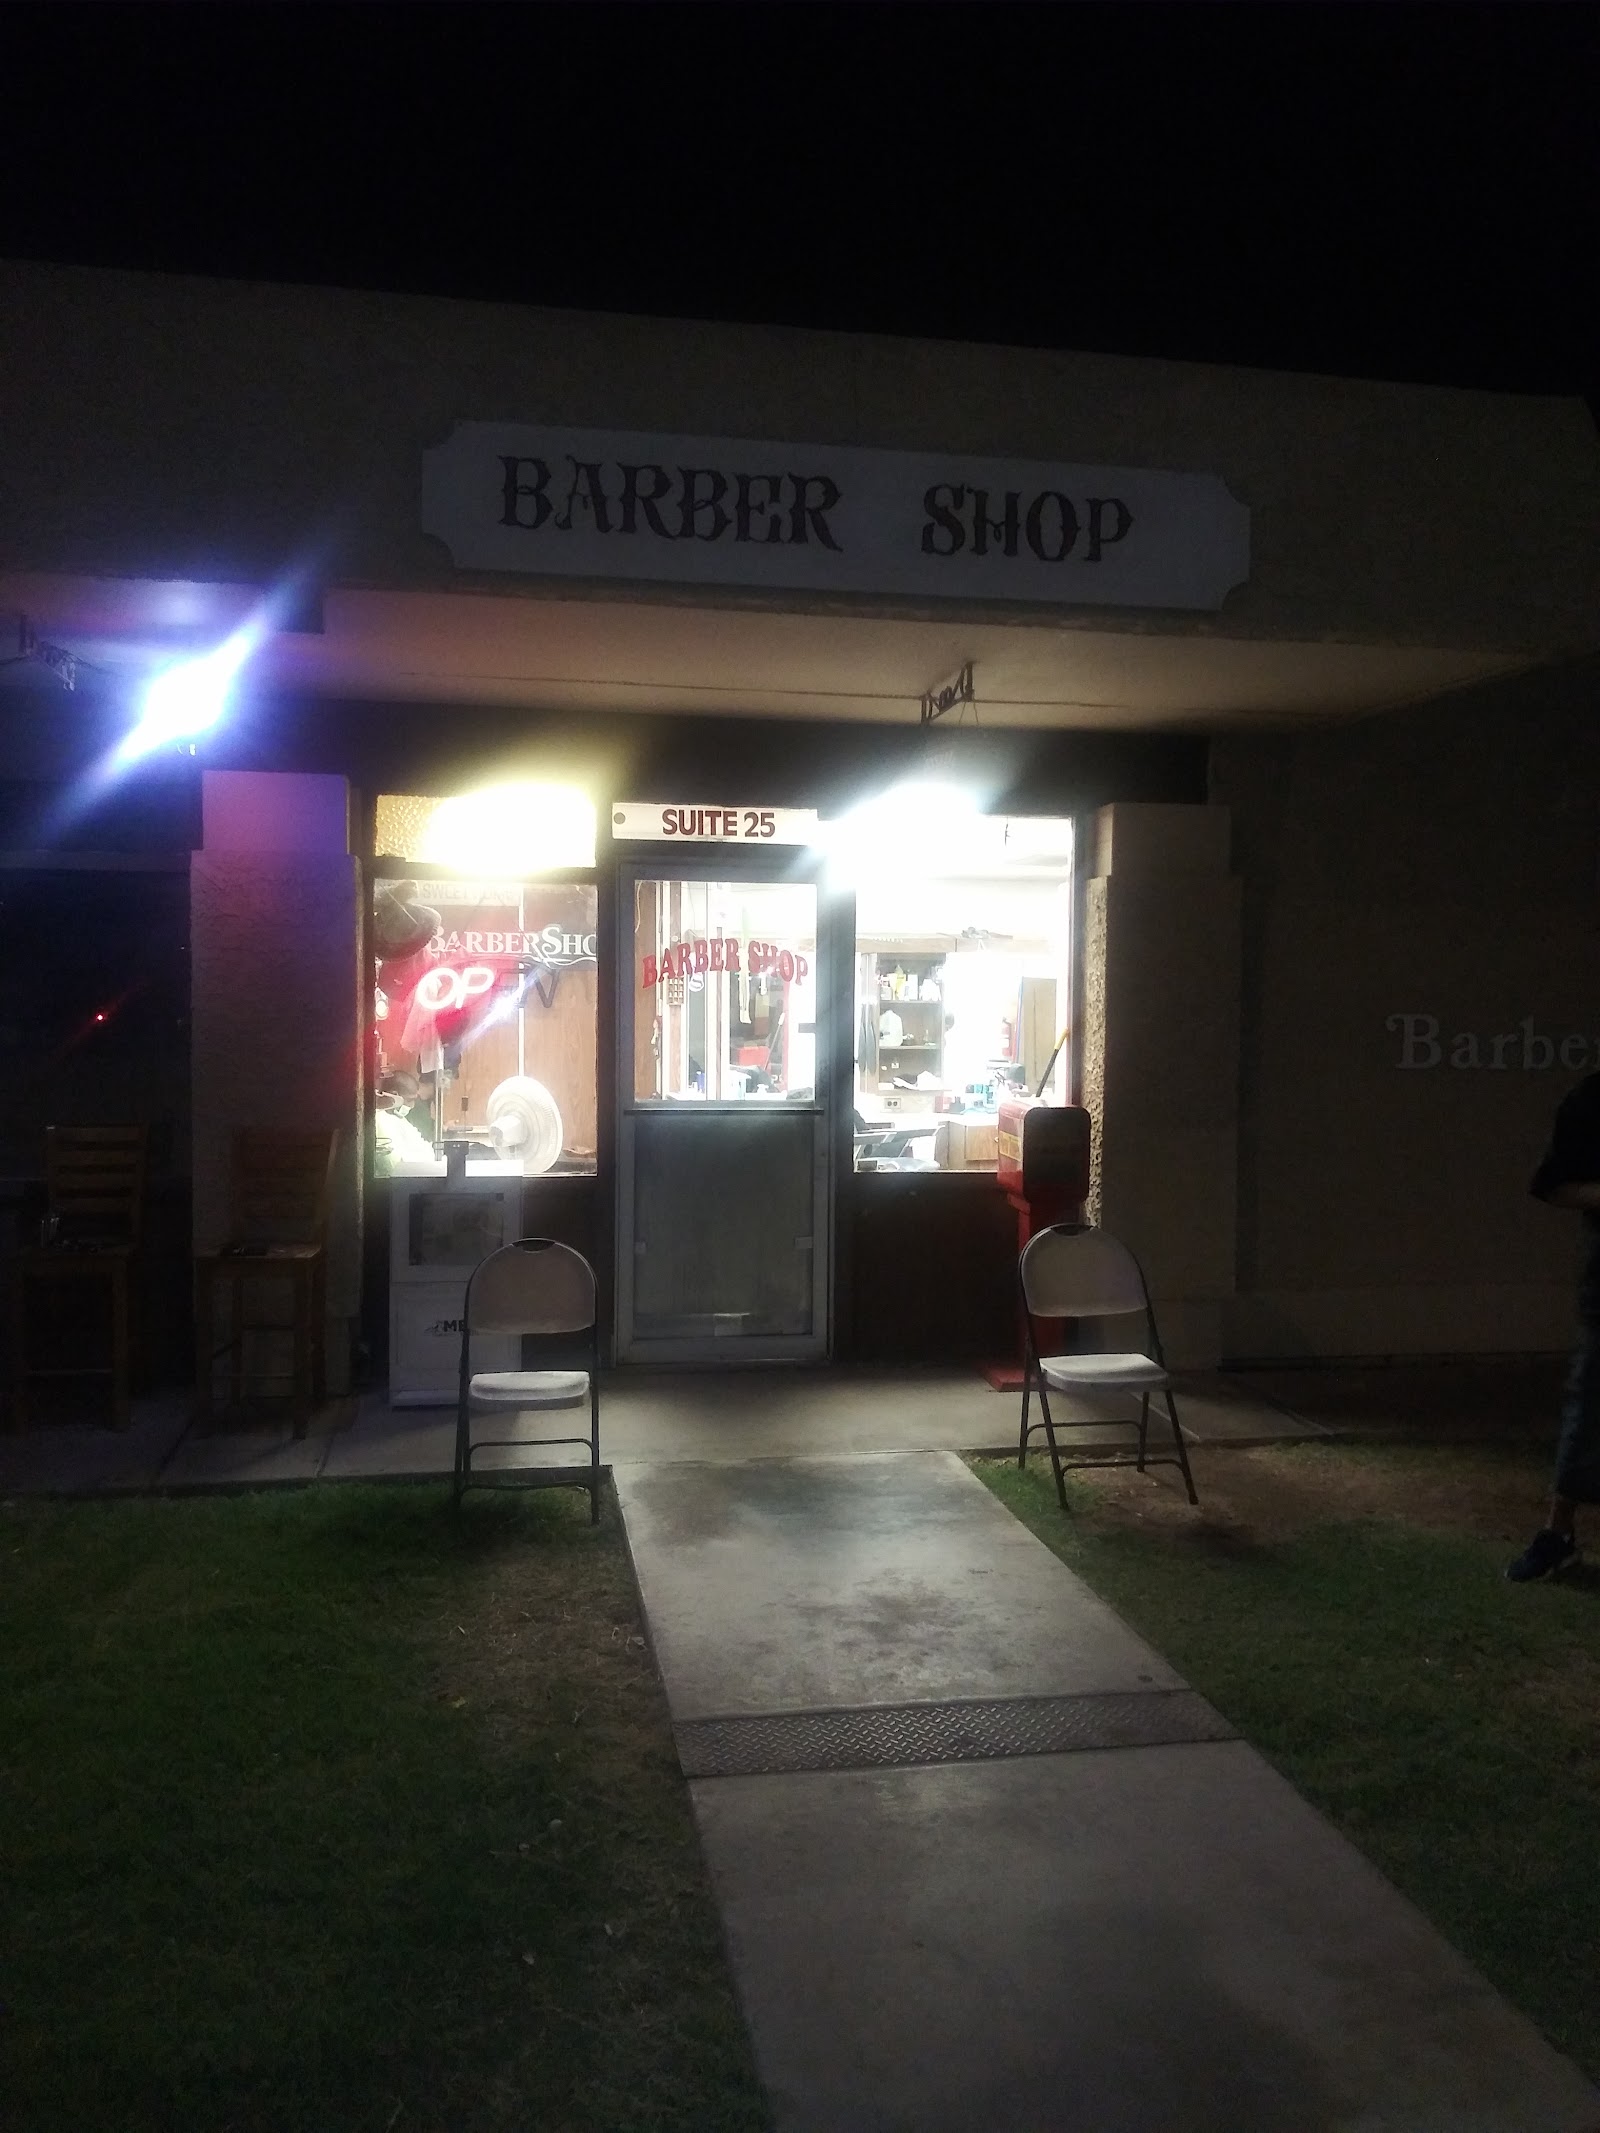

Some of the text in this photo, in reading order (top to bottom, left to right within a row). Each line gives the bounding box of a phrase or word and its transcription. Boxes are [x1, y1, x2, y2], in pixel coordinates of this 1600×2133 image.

[498, 455, 1134, 562] BARBER SHOP
[661, 808, 776, 838] SUITE 25
[642, 938, 808, 990] BARBER SHOP
[1385, 1013, 1600, 1071] Barbe
